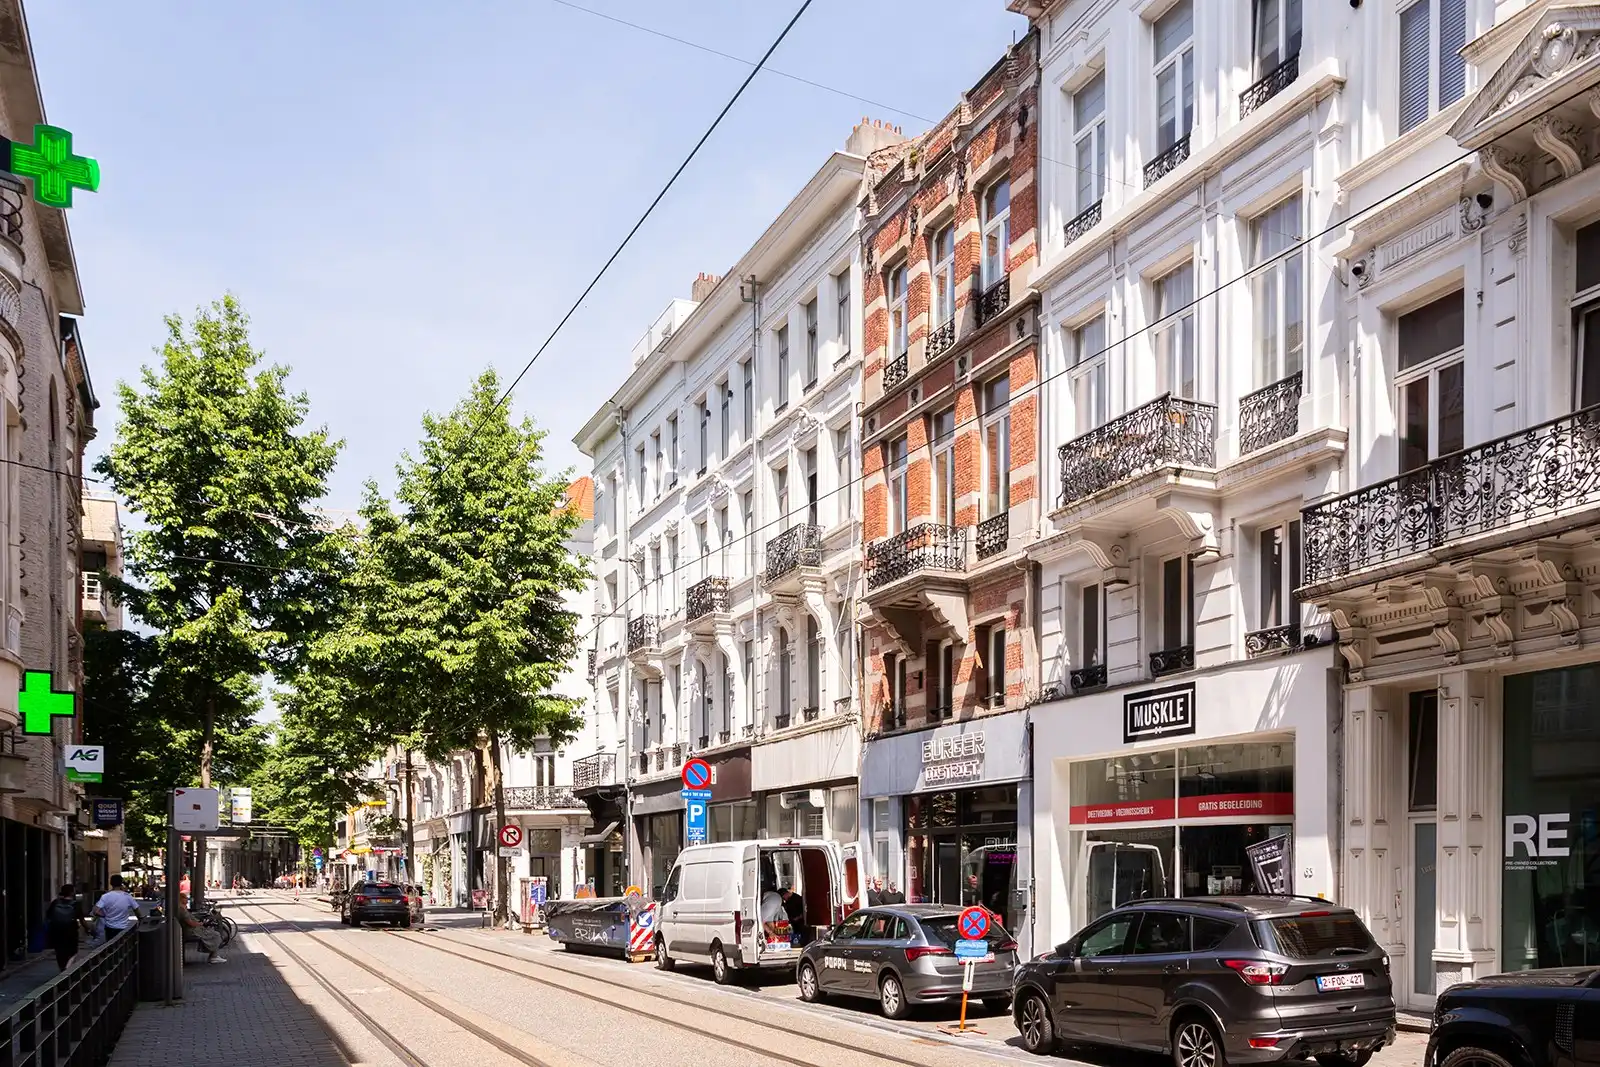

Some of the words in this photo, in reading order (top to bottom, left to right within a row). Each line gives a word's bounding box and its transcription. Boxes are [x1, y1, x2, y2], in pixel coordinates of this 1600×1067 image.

[1134, 698, 1184, 727] MUSKLE
[70, 749, 99, 761] AG
[922, 731, 985, 762] BURGER
[690, 804, 703, 822] P
[1198, 802, 1218, 811] GRATIS
[1219, 800, 1263, 810] BEGELEIDING
[1505, 813, 1570, 857] RE
